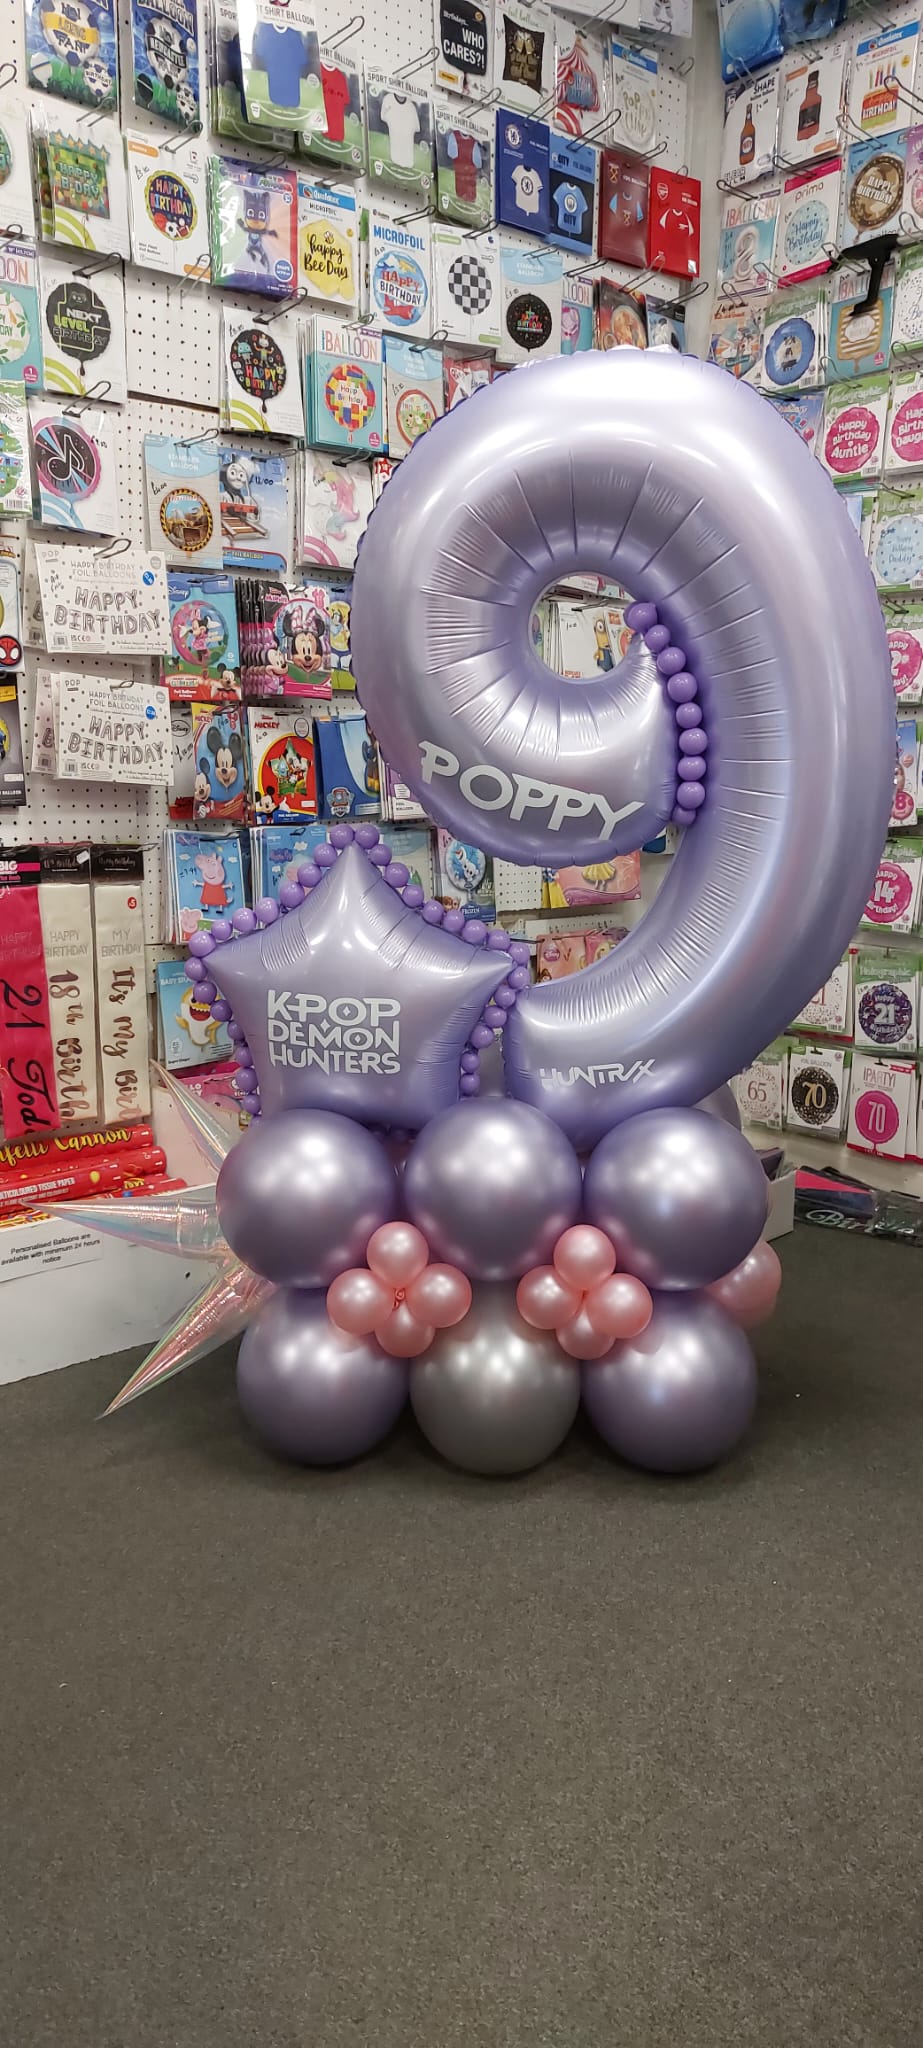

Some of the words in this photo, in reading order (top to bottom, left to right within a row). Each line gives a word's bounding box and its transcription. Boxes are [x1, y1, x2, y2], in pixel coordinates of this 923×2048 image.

[264, 6, 285, 20] SHIRT
[286, 9, 316, 27] BALLOON
[461, 28, 485, 50] WHO
[443, 38, 485, 70] CARES?!
[60, 163, 98, 182] HAPPY
[156, 179, 184, 199] HAPPY
[867, 176, 893, 192] HAPPY
[151, 193, 192, 217] BIRTHDAY
[858, 185, 893, 205] BIRTHDAY
[563, 213, 577, 228] CITY
[373, 225, 426, 251] MICROFOIL
[309, 233, 345, 264] happy
[304, 252, 326, 272] Bee
[326, 263, 349, 280] Day
[380, 281, 422, 306] BIRTHDAY
[54, 313, 90, 333] LEVEL
[66, 307, 102, 324] NEXT
[52, 328, 109, 346] BIRTHDAY
[246, 362, 277, 381] HAPPY
[838, 419, 868, 433] Happy
[832, 430, 872, 445] Birthday
[831, 443, 869, 459] Auntie
[70, 560, 96, 570] HAPPY
[98, 561, 136, 571] BIRTHDAY
[72, 568, 91, 577] FOIL
[93, 570, 137, 579] BALLOONS
[74, 586, 138, 612] HAPPY
[53, 604, 161, 636] BIRTHDAY
[889, 640, 909, 651] appy
[88, 690, 112, 701] HAPPY
[89, 698, 106, 708] FOIL
[107, 701, 144, 712] BALLOONS
[89, 715, 145, 742] HAPPY
[254, 721, 280, 730] MICKEY
[67, 732, 164, 765] BIRTHDAY
[418, 739, 646, 841] POPPY
[874, 880, 896, 904] 14
[462, 907, 480, 915] FROZEN
[49, 928, 81, 942] HAPPY
[112, 928, 131, 942] MY
[101, 944, 142, 957] BIRTHDAY
[874, 1003, 896, 1025] 21
[267, 1018, 400, 1056] DEMON
[268, 1040, 401, 1077] HUNTERS
[747, 1080, 767, 1103] 65
[802, 1081, 827, 1109] 70
[868, 1101, 886, 1134] 70
[54, 1128, 133, 1152] Cannon
[1, 1254, 29, 1266] available
[30, 1250, 44, 1259] with
[44, 1244, 73, 1256] minimum
[74, 1242, 83, 1250] 24
[83, 1239, 101, 1249] hours
[10, 1240, 52, 1255] Personalised
[52, 1235, 80, 1247] Balloons
[80, 1233, 91, 1241] are
[42, 1255, 62, 1265] notice
